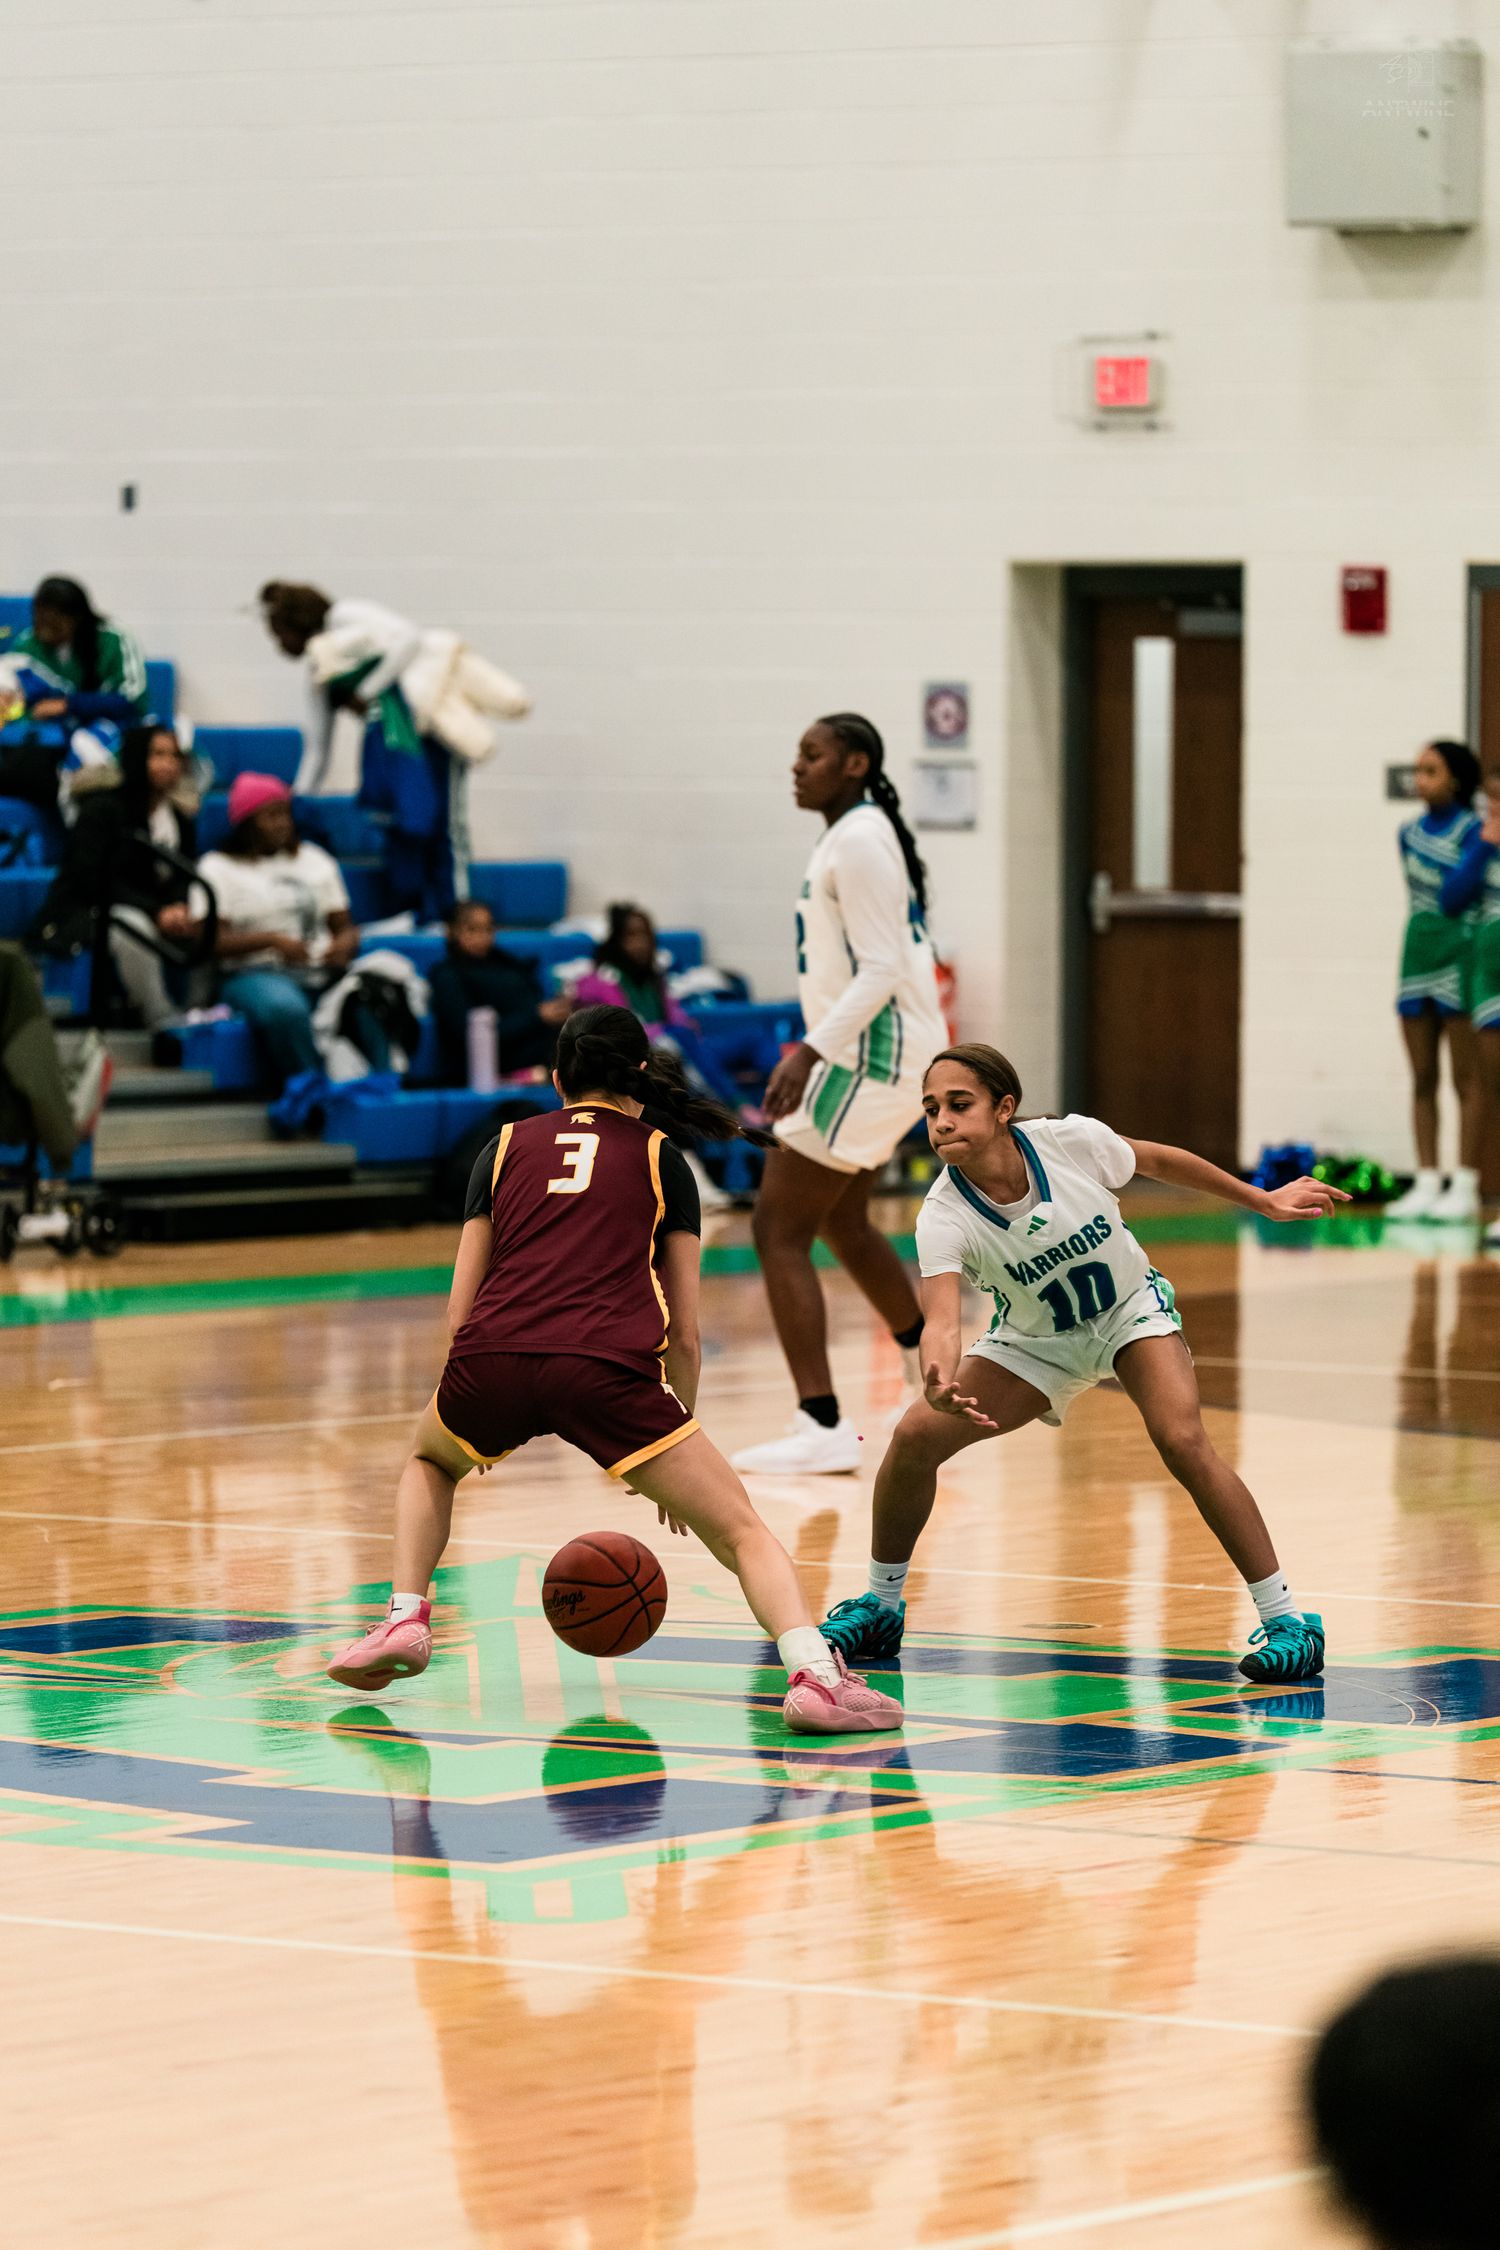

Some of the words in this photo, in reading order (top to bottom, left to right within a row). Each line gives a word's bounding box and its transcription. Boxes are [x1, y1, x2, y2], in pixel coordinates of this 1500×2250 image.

[546, 1132, 601, 1195] 3
[1036, 1260, 1118, 1333] 10
[546, 1588, 586, 1616] lings
